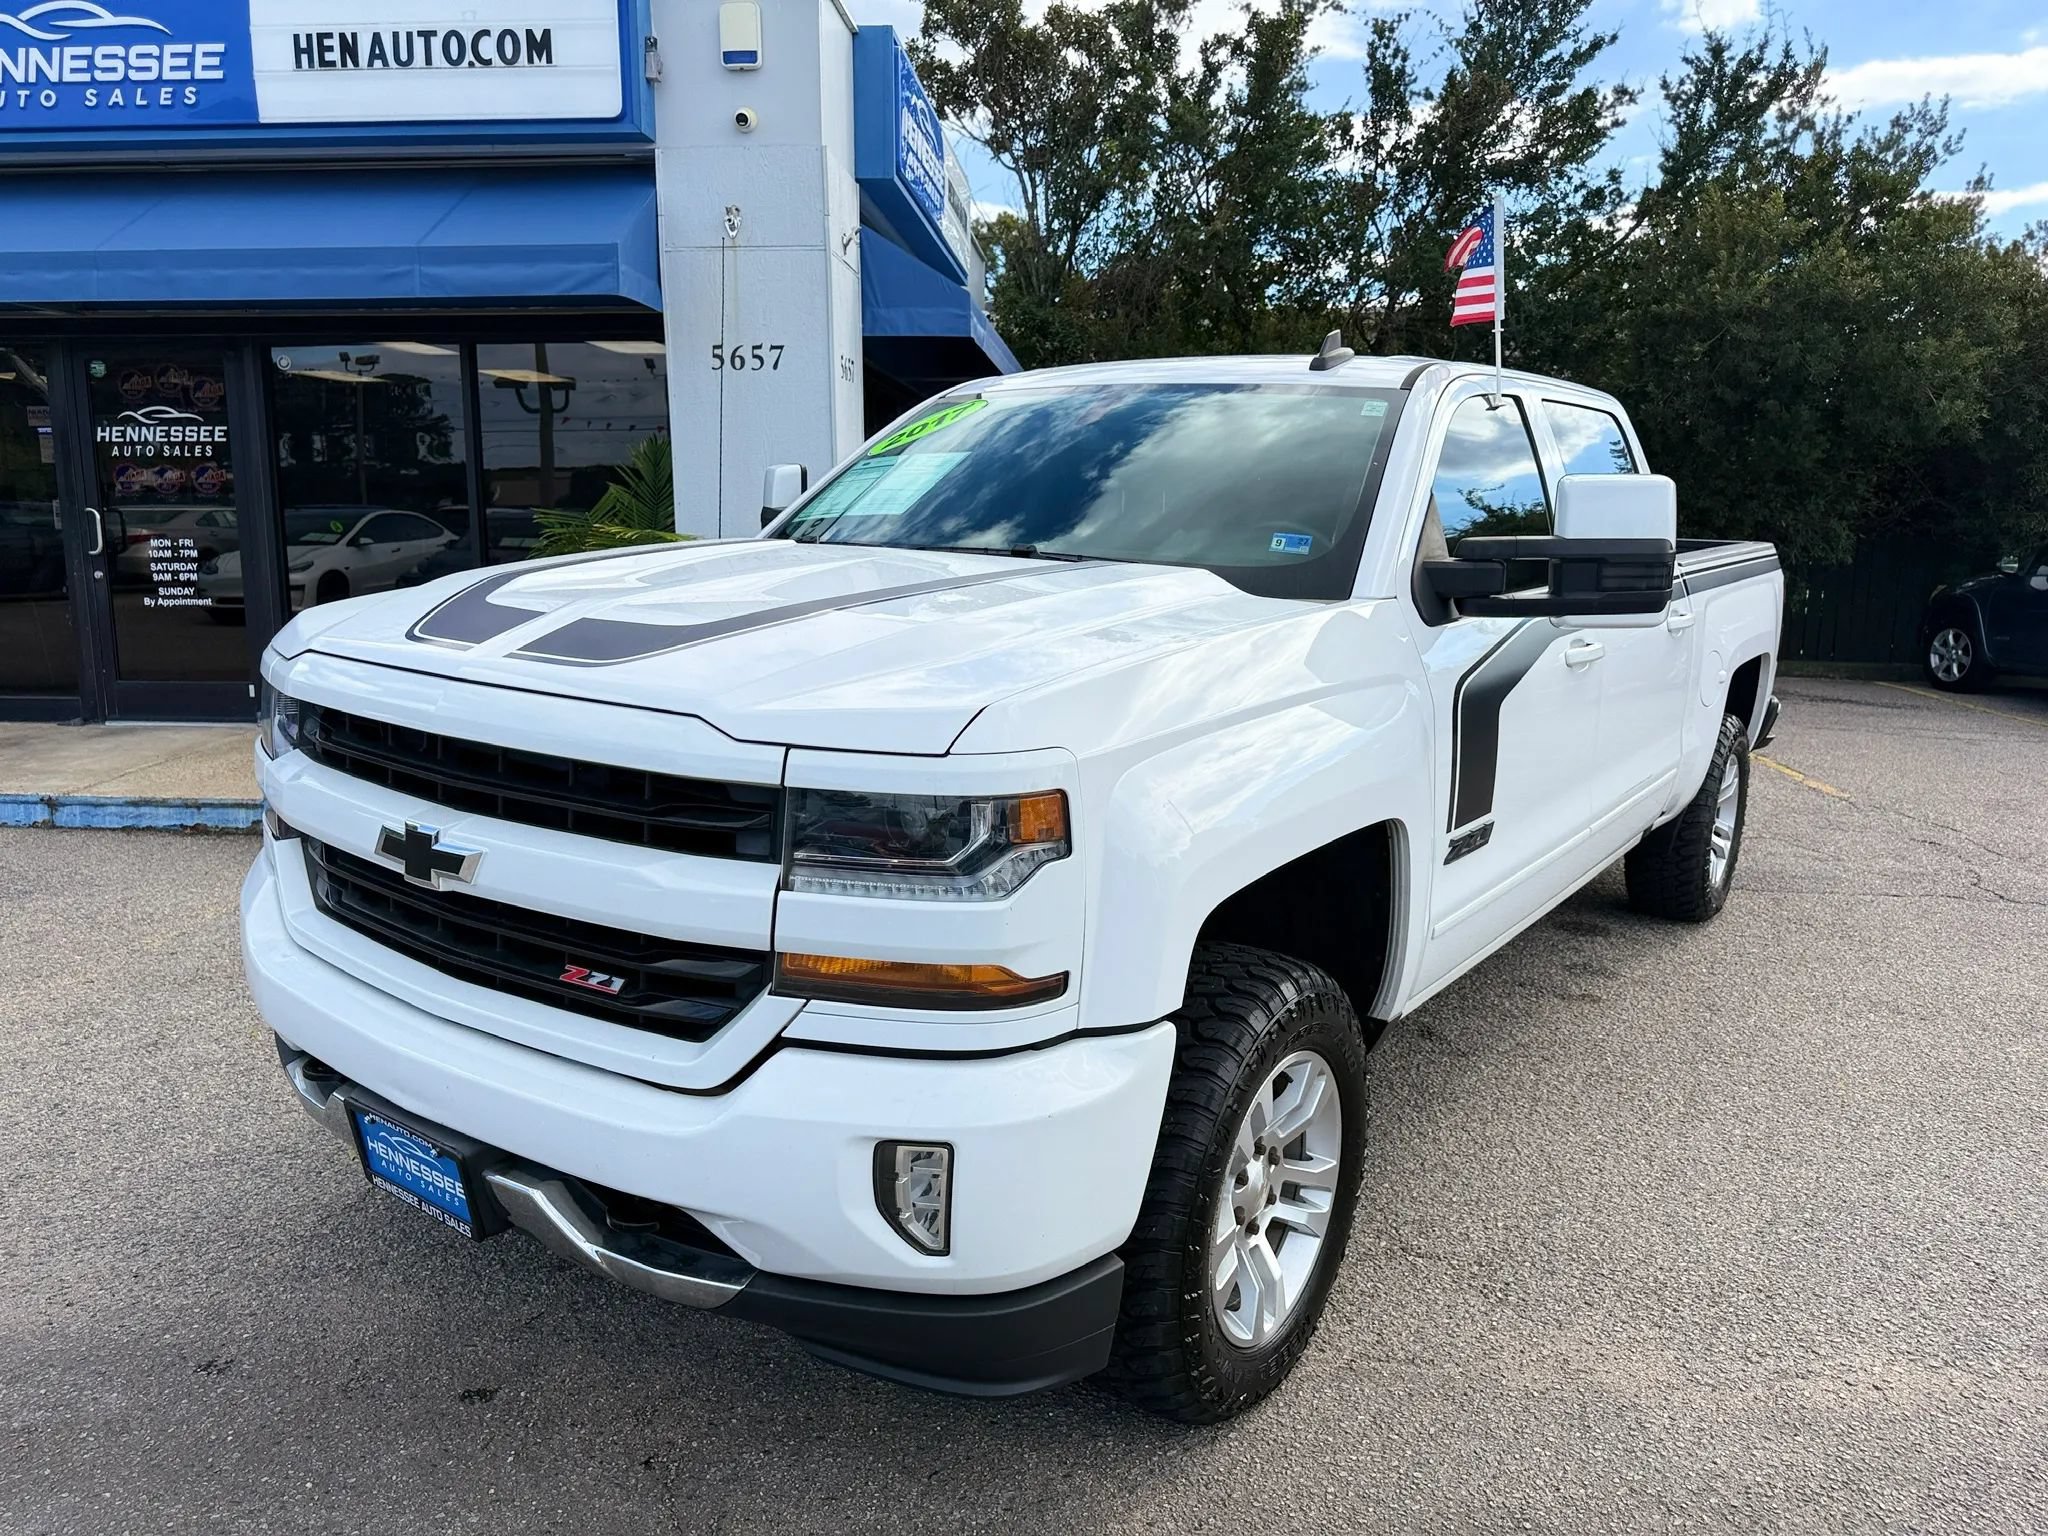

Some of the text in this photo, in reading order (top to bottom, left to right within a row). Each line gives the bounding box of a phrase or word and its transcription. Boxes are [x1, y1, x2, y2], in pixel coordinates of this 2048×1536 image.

[292, 28, 554, 69] HENAUTO.COM
[0, 43, 226, 84] NNESSEE
[0, 86, 197, 109] TO SALES
[711, 343, 785, 371] 5657
[840, 354, 855, 384] 5657
[96, 426, 228, 442] HENNESSEE
[880, 401, 977, 451] 2017
[112, 445, 213, 457] AUTO SALES
[148, 549, 172, 558] 10AM
[179, 549, 198, 558] 7PM
[150, 539, 171, 547] MON
[178, 539, 194, 547] FRI
[1275, 538, 1283, 547] 9
[150, 562, 198, 571] SATURDAY
[152, 573, 172, 581] 9AM
[179, 573, 198, 581] 6PM
[143, 597, 213, 608] By Appointment
[158, 587, 195, 596] SUNDAY
[560, 964, 626, 995] Z71
[366, 1135, 466, 1200] HENNESSEE
[381, 1160, 459, 1206] AUTO SALES
[372, 1174, 472, 1238] HENNESSEE AUTO SALES
